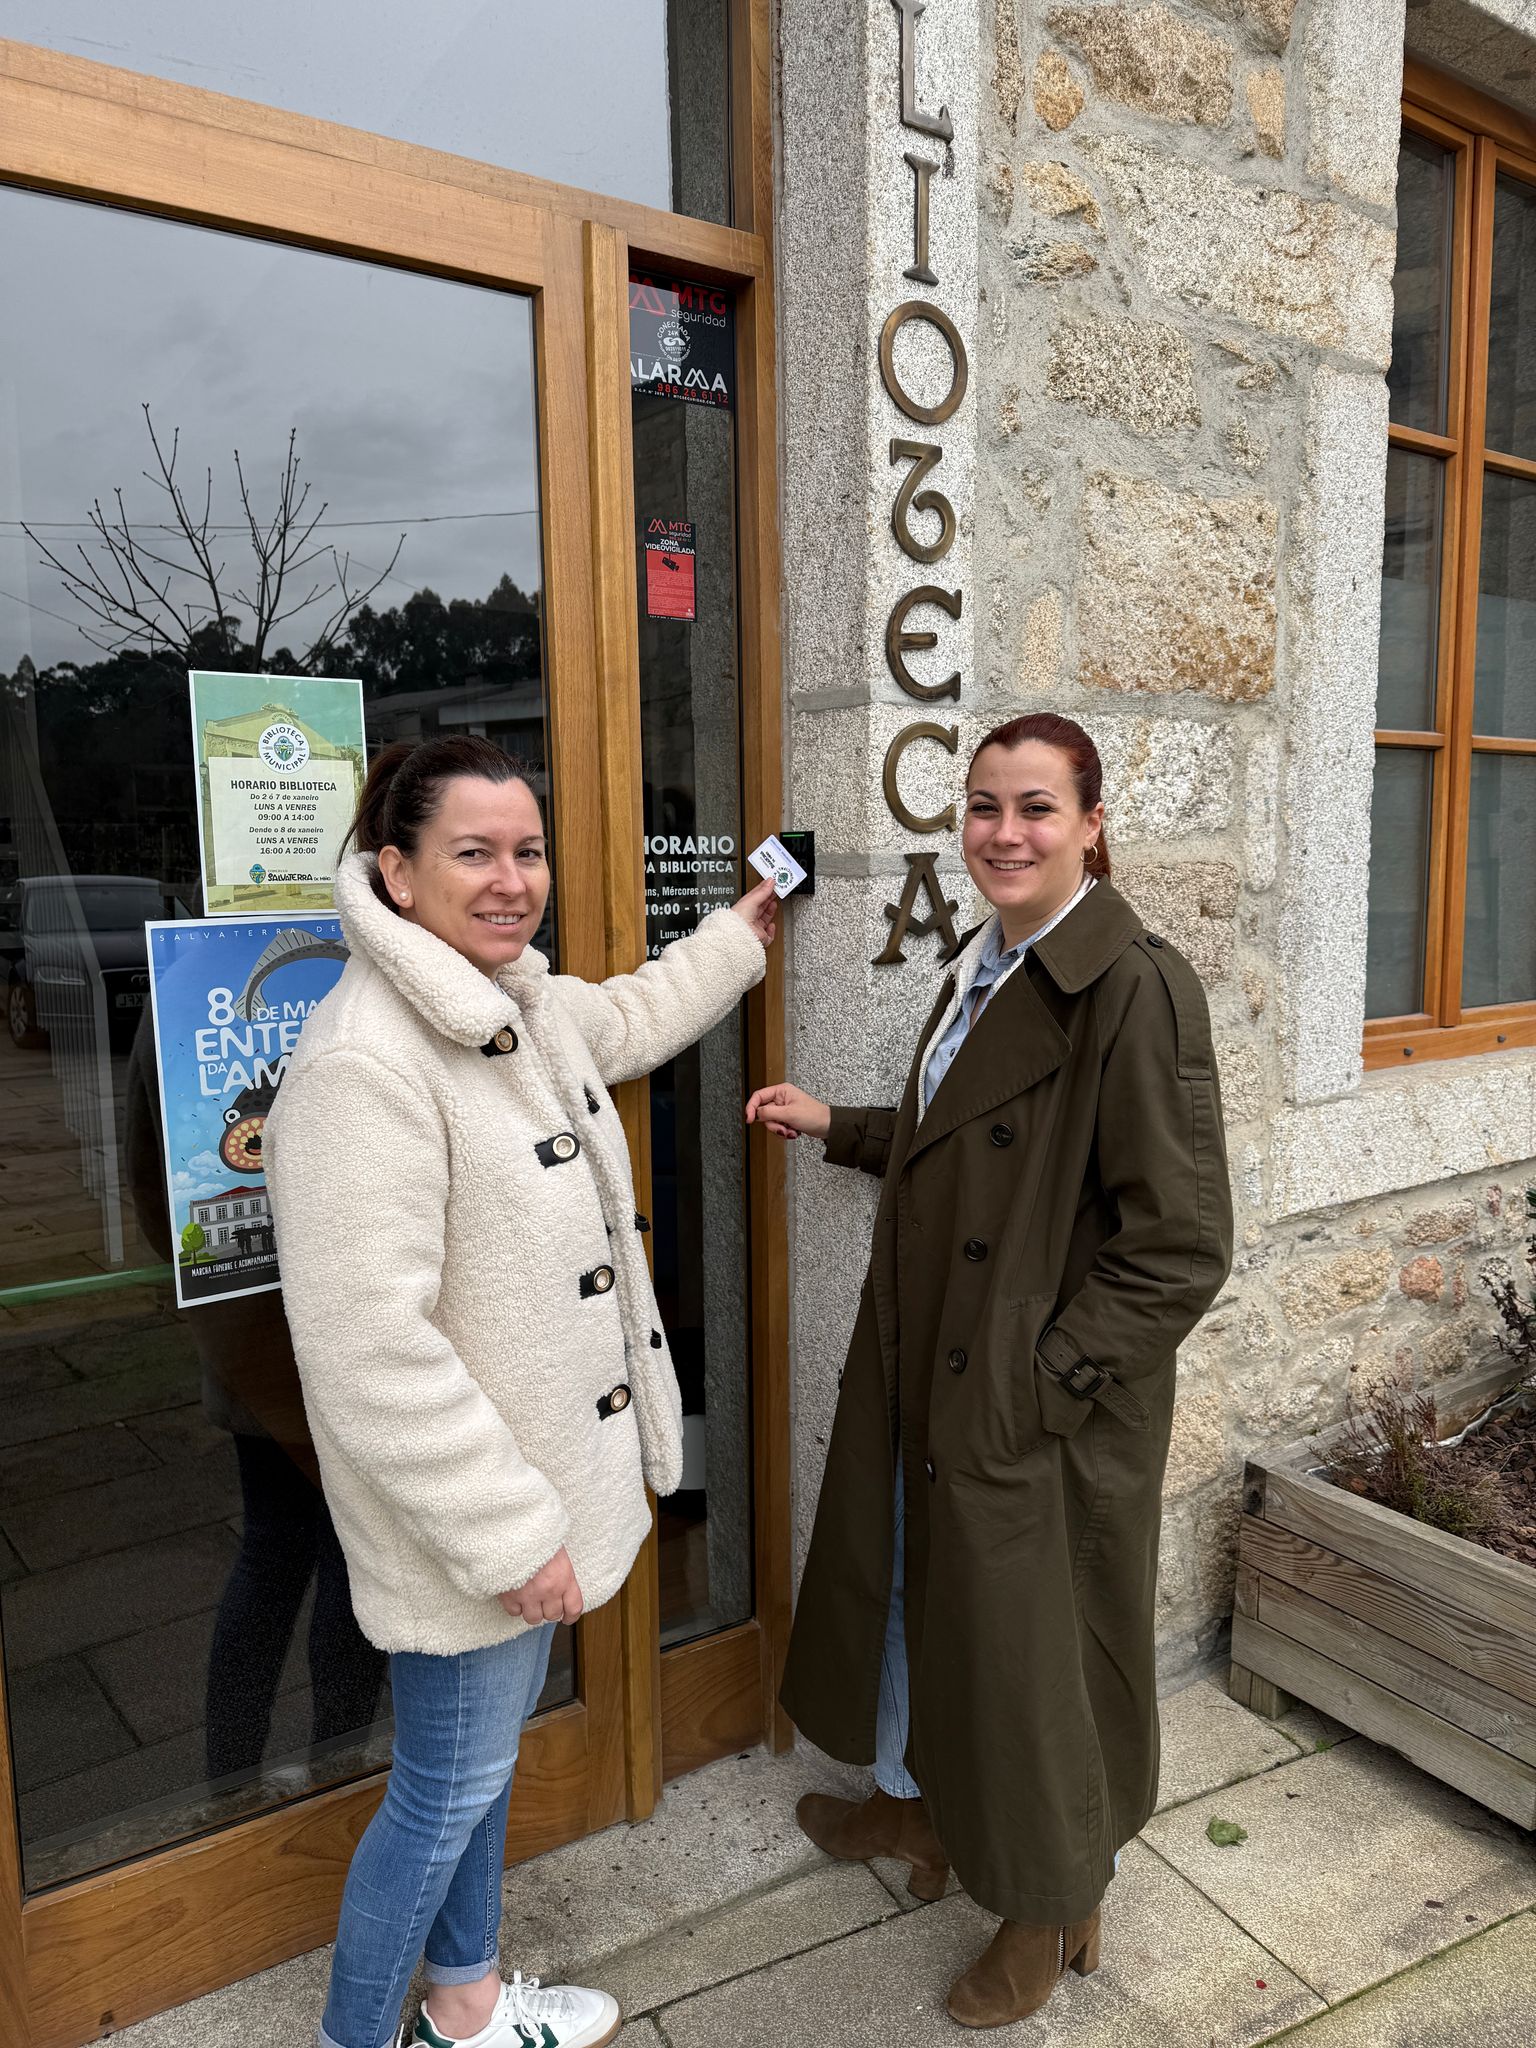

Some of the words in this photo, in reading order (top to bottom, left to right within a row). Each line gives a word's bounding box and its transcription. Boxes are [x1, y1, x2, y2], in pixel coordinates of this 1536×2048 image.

[671, 282, 726, 315] MTG
[671, 309, 726, 328] seguridad
[657, 321, 690, 341] CONECTADA
[657, 383, 678, 395] 986
[684, 387, 697, 398] 26
[701, 390, 713, 401] 61
[717, 393, 729, 404] 12
[669, 521, 691, 532] MTG
[645, 542, 696, 555] VIDEOVIGILADA
[660, 538, 679, 547] ZONA
[262, 726, 305, 746] BIBLIOTECA
[263, 752, 306, 771] MUNICIPAL
[231, 780, 277, 790] HORARIO
[279, 781, 337, 791] BIBLIOTECA
[282, 793, 291, 801] de
[254, 803, 275, 811] LUNS
[277, 803, 283, 811] A
[285, 803, 317, 811] VENRES
[644, 861, 656, 874] A
[660, 860, 734, 874] BIBLIOTECA
[267, 873, 313, 882] SALVATERRA
[662, 885, 699, 896] Mércores
[701, 887, 706, 895] e
[708, 885, 735, 895] Venres
[159, 927, 296, 942] SALVATERRA
[316, 925, 336, 933] DE
[660, 929, 679, 939] Luns
[207, 987, 236, 1026] 8
[256, 1006, 280, 1021] DE
[208, 1062, 228, 1075] DA
[191, 1265, 212, 1278] MARCHA
[212, 1261, 233, 1273] FÚNEBRE
[234, 1260, 238, 1269] E
